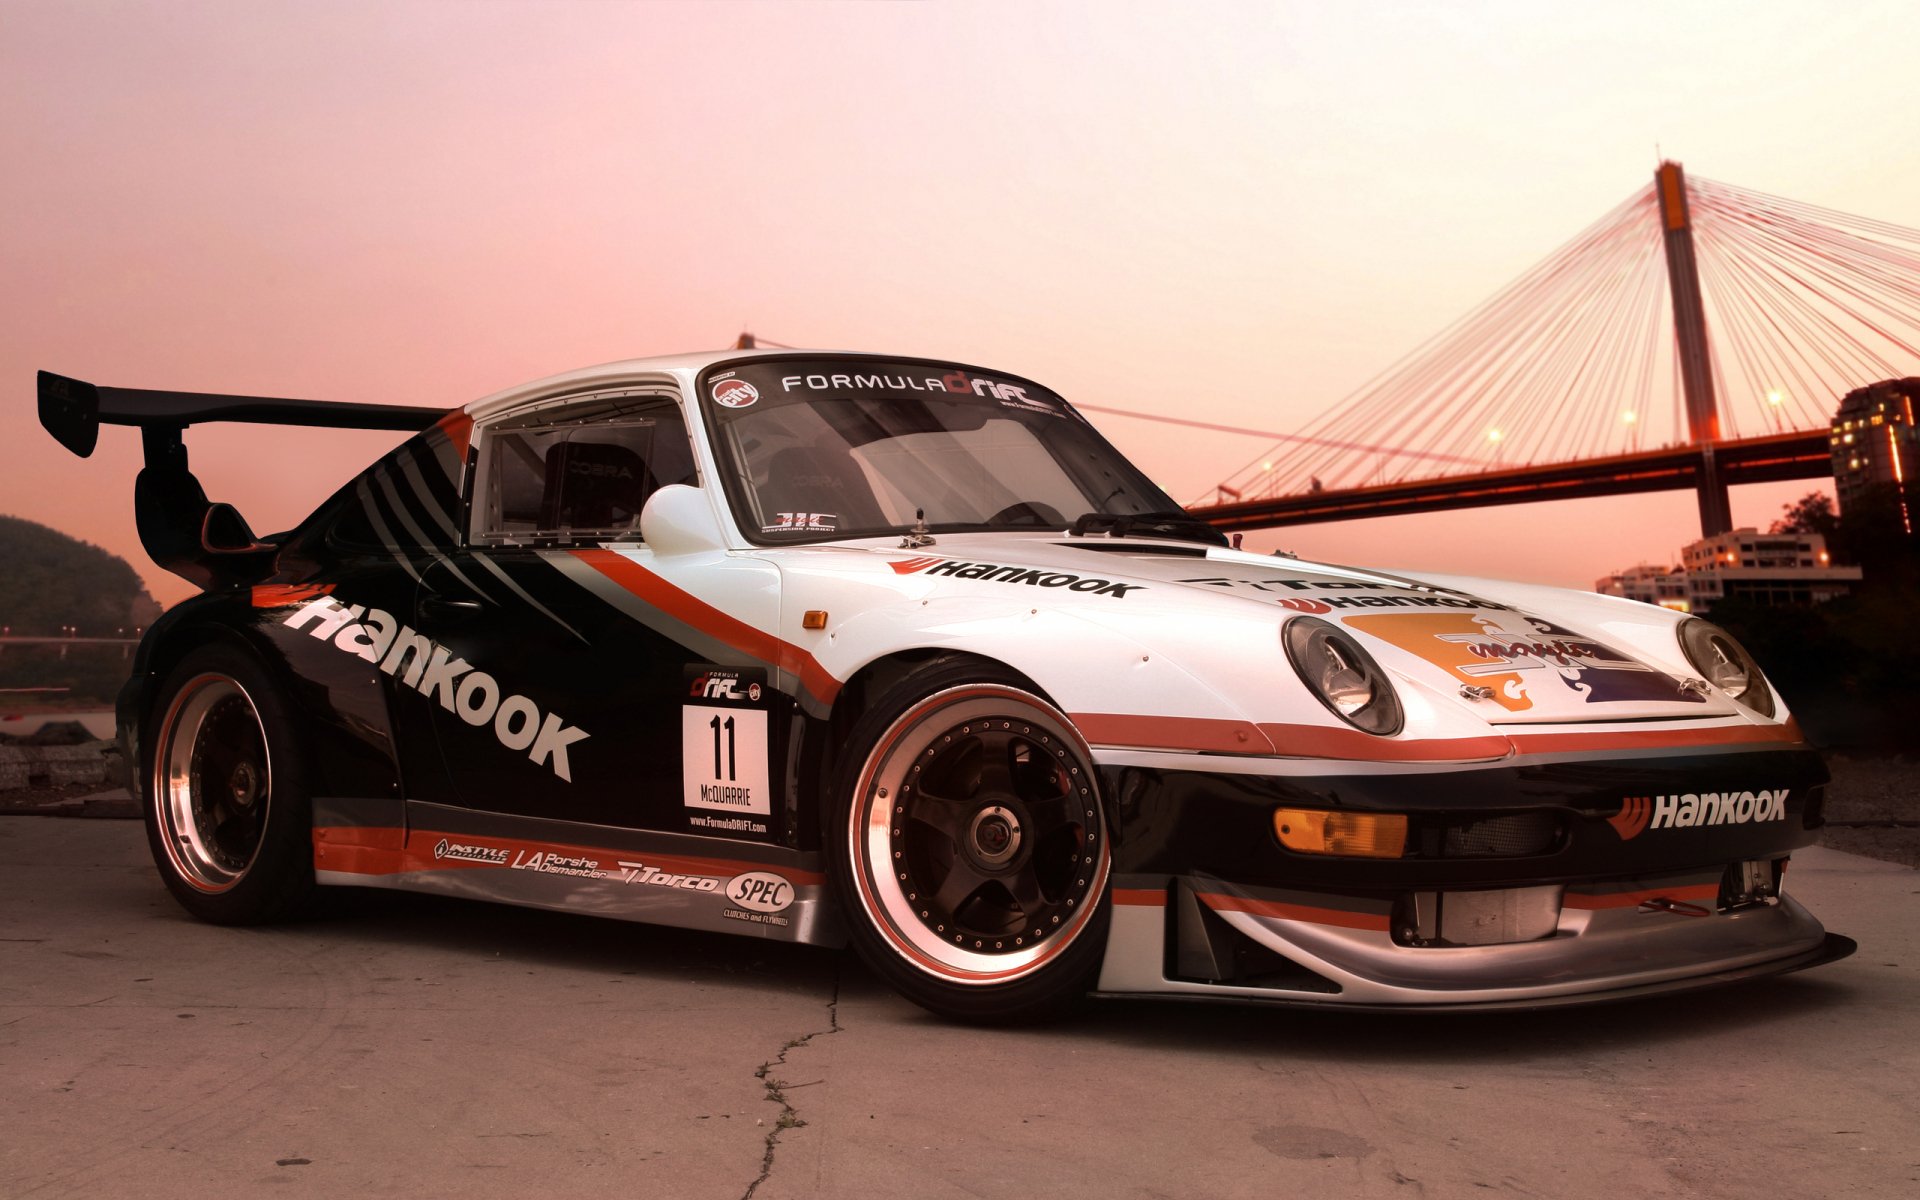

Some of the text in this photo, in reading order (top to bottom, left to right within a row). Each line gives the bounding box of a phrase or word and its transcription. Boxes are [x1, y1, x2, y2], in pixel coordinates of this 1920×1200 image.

[781, 374, 947, 392] FORMULA
[568, 460, 633, 480] COBRA
[791, 475, 844, 488] COBRA
[710, 714, 736, 781] 11
[701, 784, 751, 806] McQUARRIE
[690, 816, 766, 833] www.FormulaDRIFT.com
[511, 850, 543, 871] LA
[545, 853, 599, 868] Porshe
[539, 863, 607, 879] Dismantler
[638, 867, 720, 891] Torco
[735, 878, 787, 906] SPEC
[724, 909, 749, 920] CLUTCHES
[750, 914, 762, 922] and
